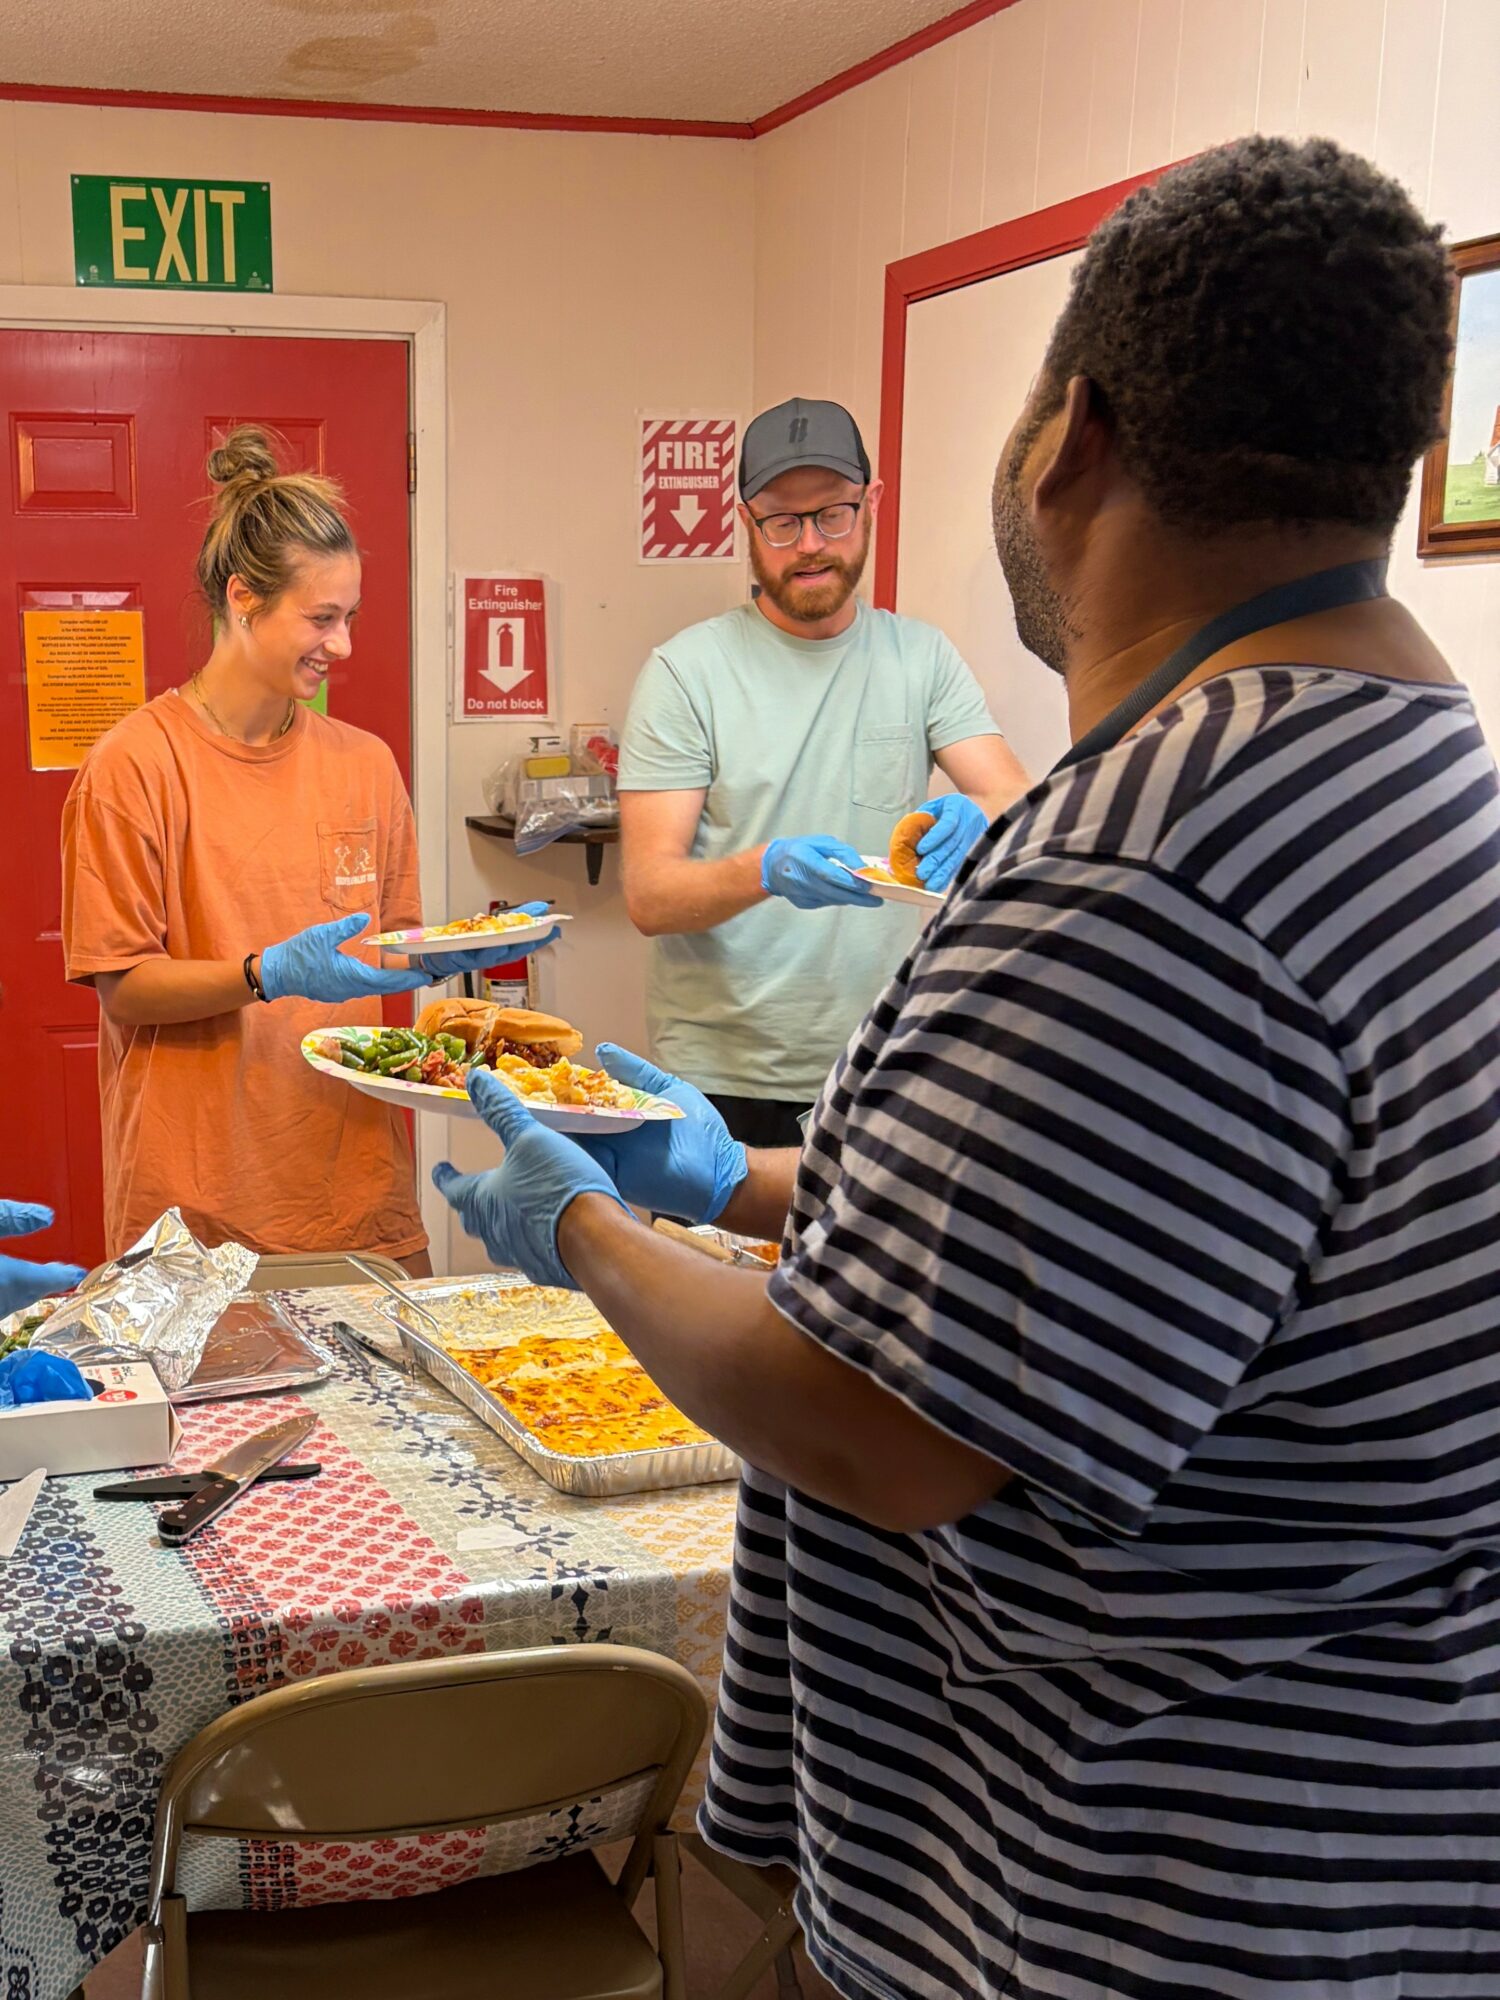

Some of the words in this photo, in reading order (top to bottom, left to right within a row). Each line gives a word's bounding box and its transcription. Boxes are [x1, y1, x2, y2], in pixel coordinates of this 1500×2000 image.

[109, 185, 246, 283] EXIT
[658, 441, 720, 470] FIRE
[658, 475, 720, 489] EXTINGUISHER
[494, 584, 518, 596] Fire
[468, 598, 543, 612] Extinguisher
[467, 698, 484, 710] Do
[486, 698, 508, 710] not
[510, 698, 544, 710] block
